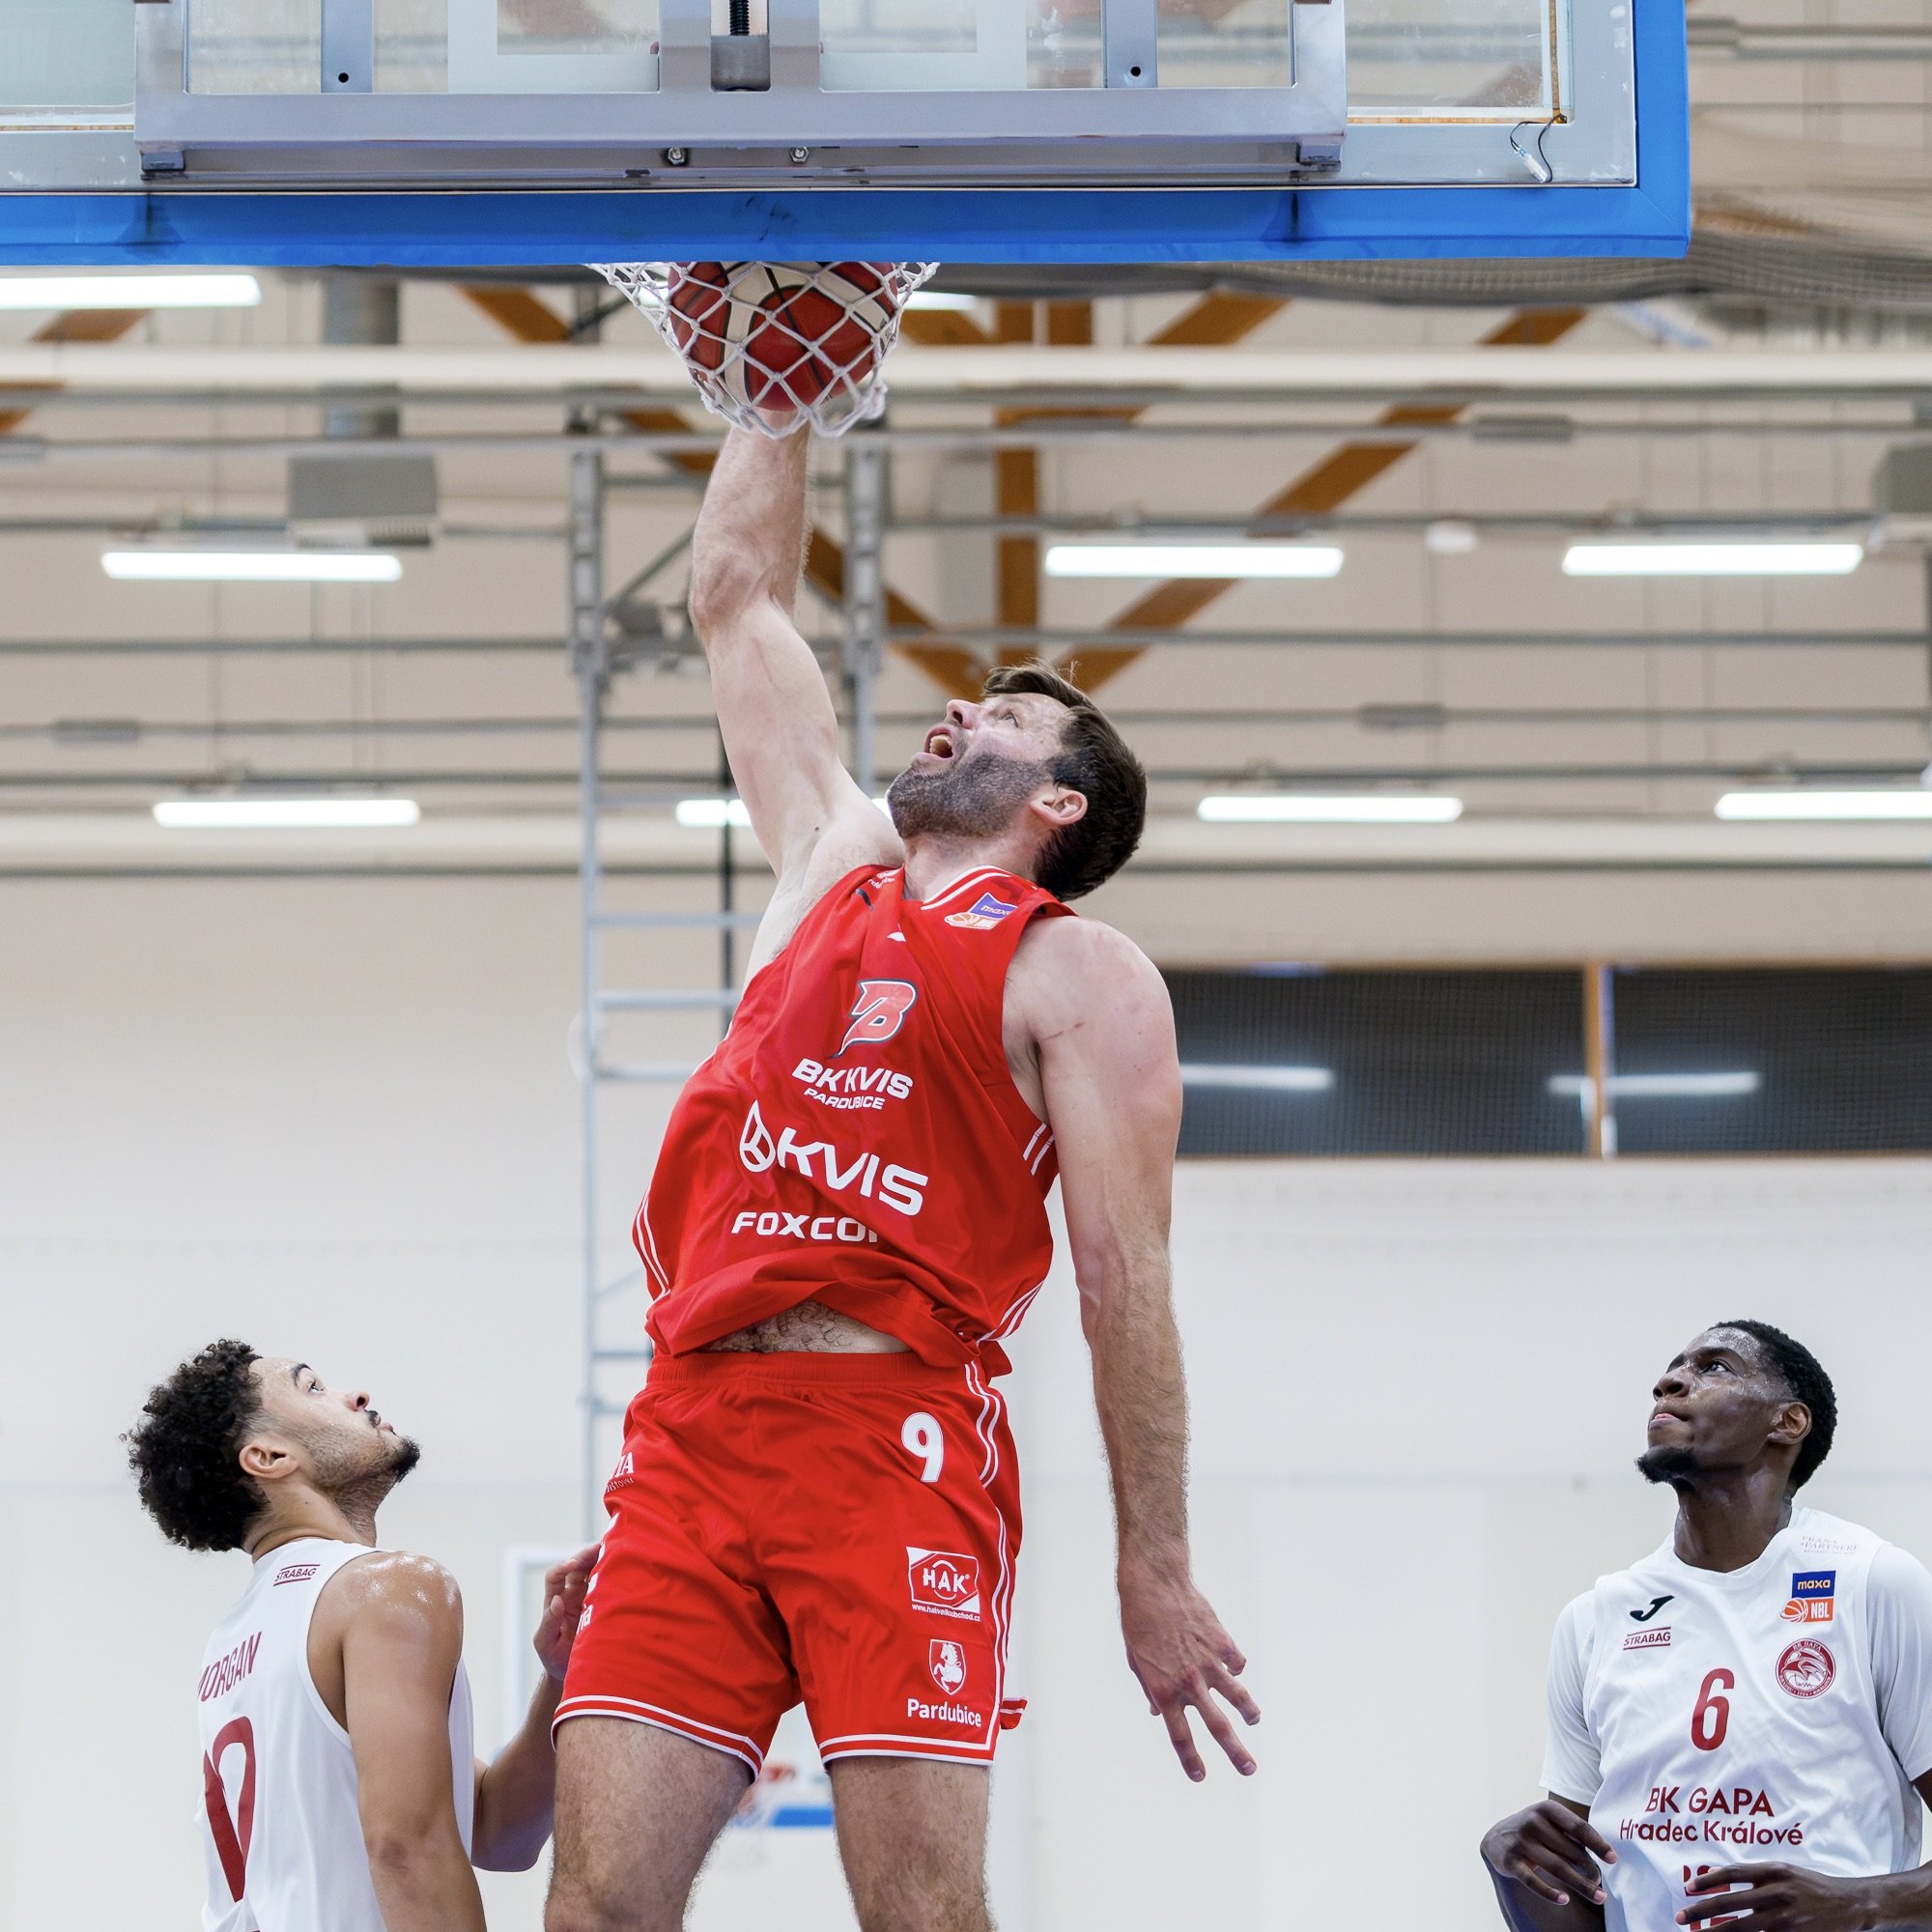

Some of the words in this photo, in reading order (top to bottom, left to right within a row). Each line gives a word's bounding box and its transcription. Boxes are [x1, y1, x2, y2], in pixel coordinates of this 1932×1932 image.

[792, 1058, 846, 1093] BK
[844, 1066, 914, 1099] KVIS
[804, 1088, 886, 1110] PARDUBICE
[777, 1126, 928, 1216] KVIS
[901, 1412, 944, 1483] 9
[274, 1568, 317, 1582] STRABAG
[923, 1568, 968, 1595] HAK
[1798, 1579, 1832, 1590] maxa
[1811, 1602, 1831, 1620] NBL
[1624, 1632, 1671, 1646] STRABAG
[907, 1698, 982, 1727] Pardubice
[1690, 1668, 1735, 1751] 6
[1645, 1787, 1681, 1813] BK
[1689, 1787, 1775, 1817] GAPA
[1620, 1818, 1698, 1842] Hradec
[1704, 1820, 1804, 1846] Králové
